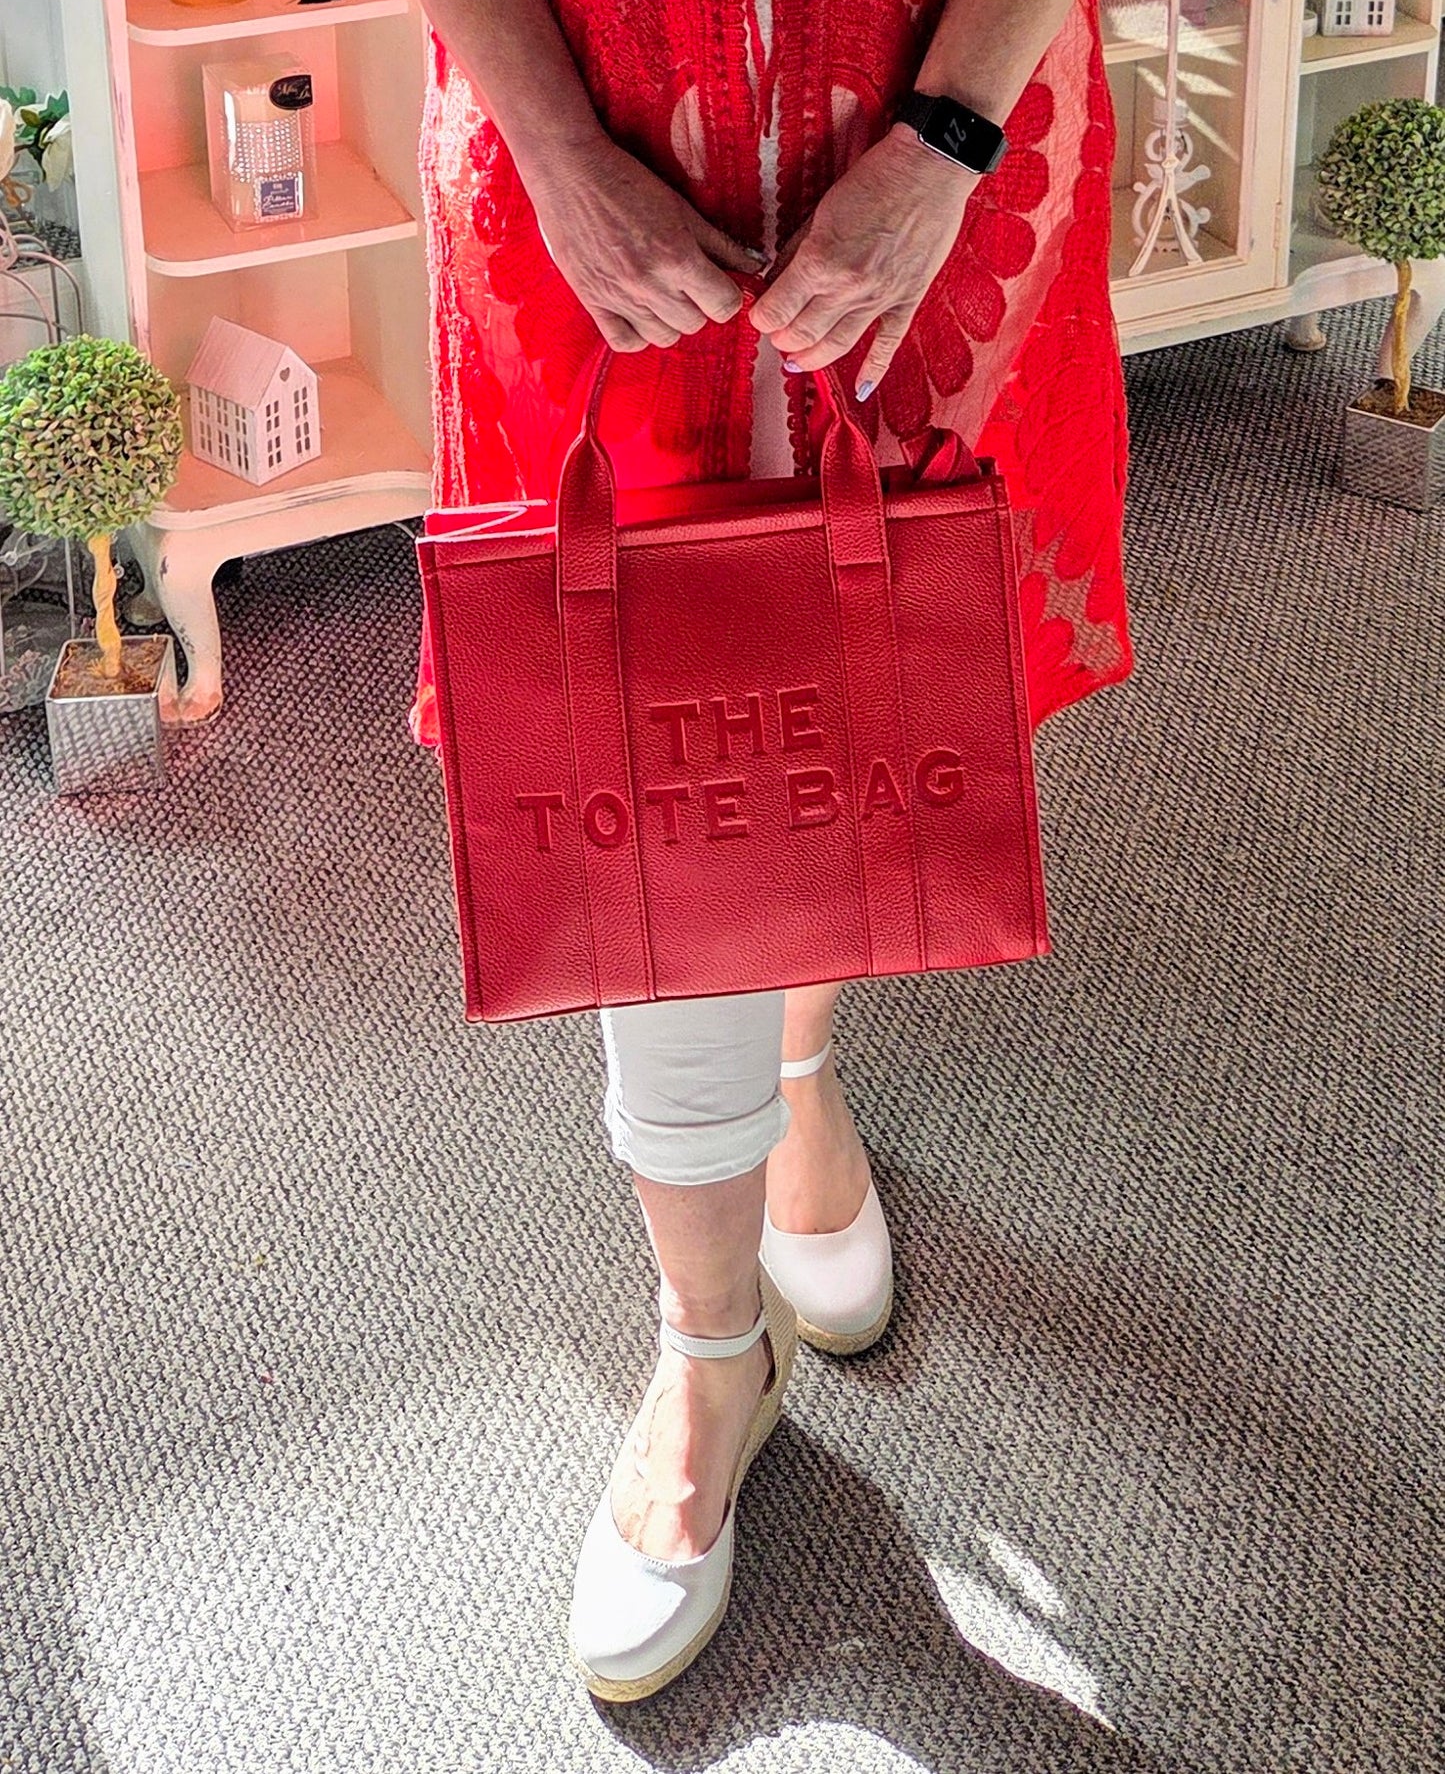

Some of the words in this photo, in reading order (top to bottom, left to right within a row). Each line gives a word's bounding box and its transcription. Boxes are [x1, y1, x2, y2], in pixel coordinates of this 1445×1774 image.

[646, 684, 824, 766] THE
[515, 778, 751, 853] TOTE
[786, 748, 966, 832] BAG
